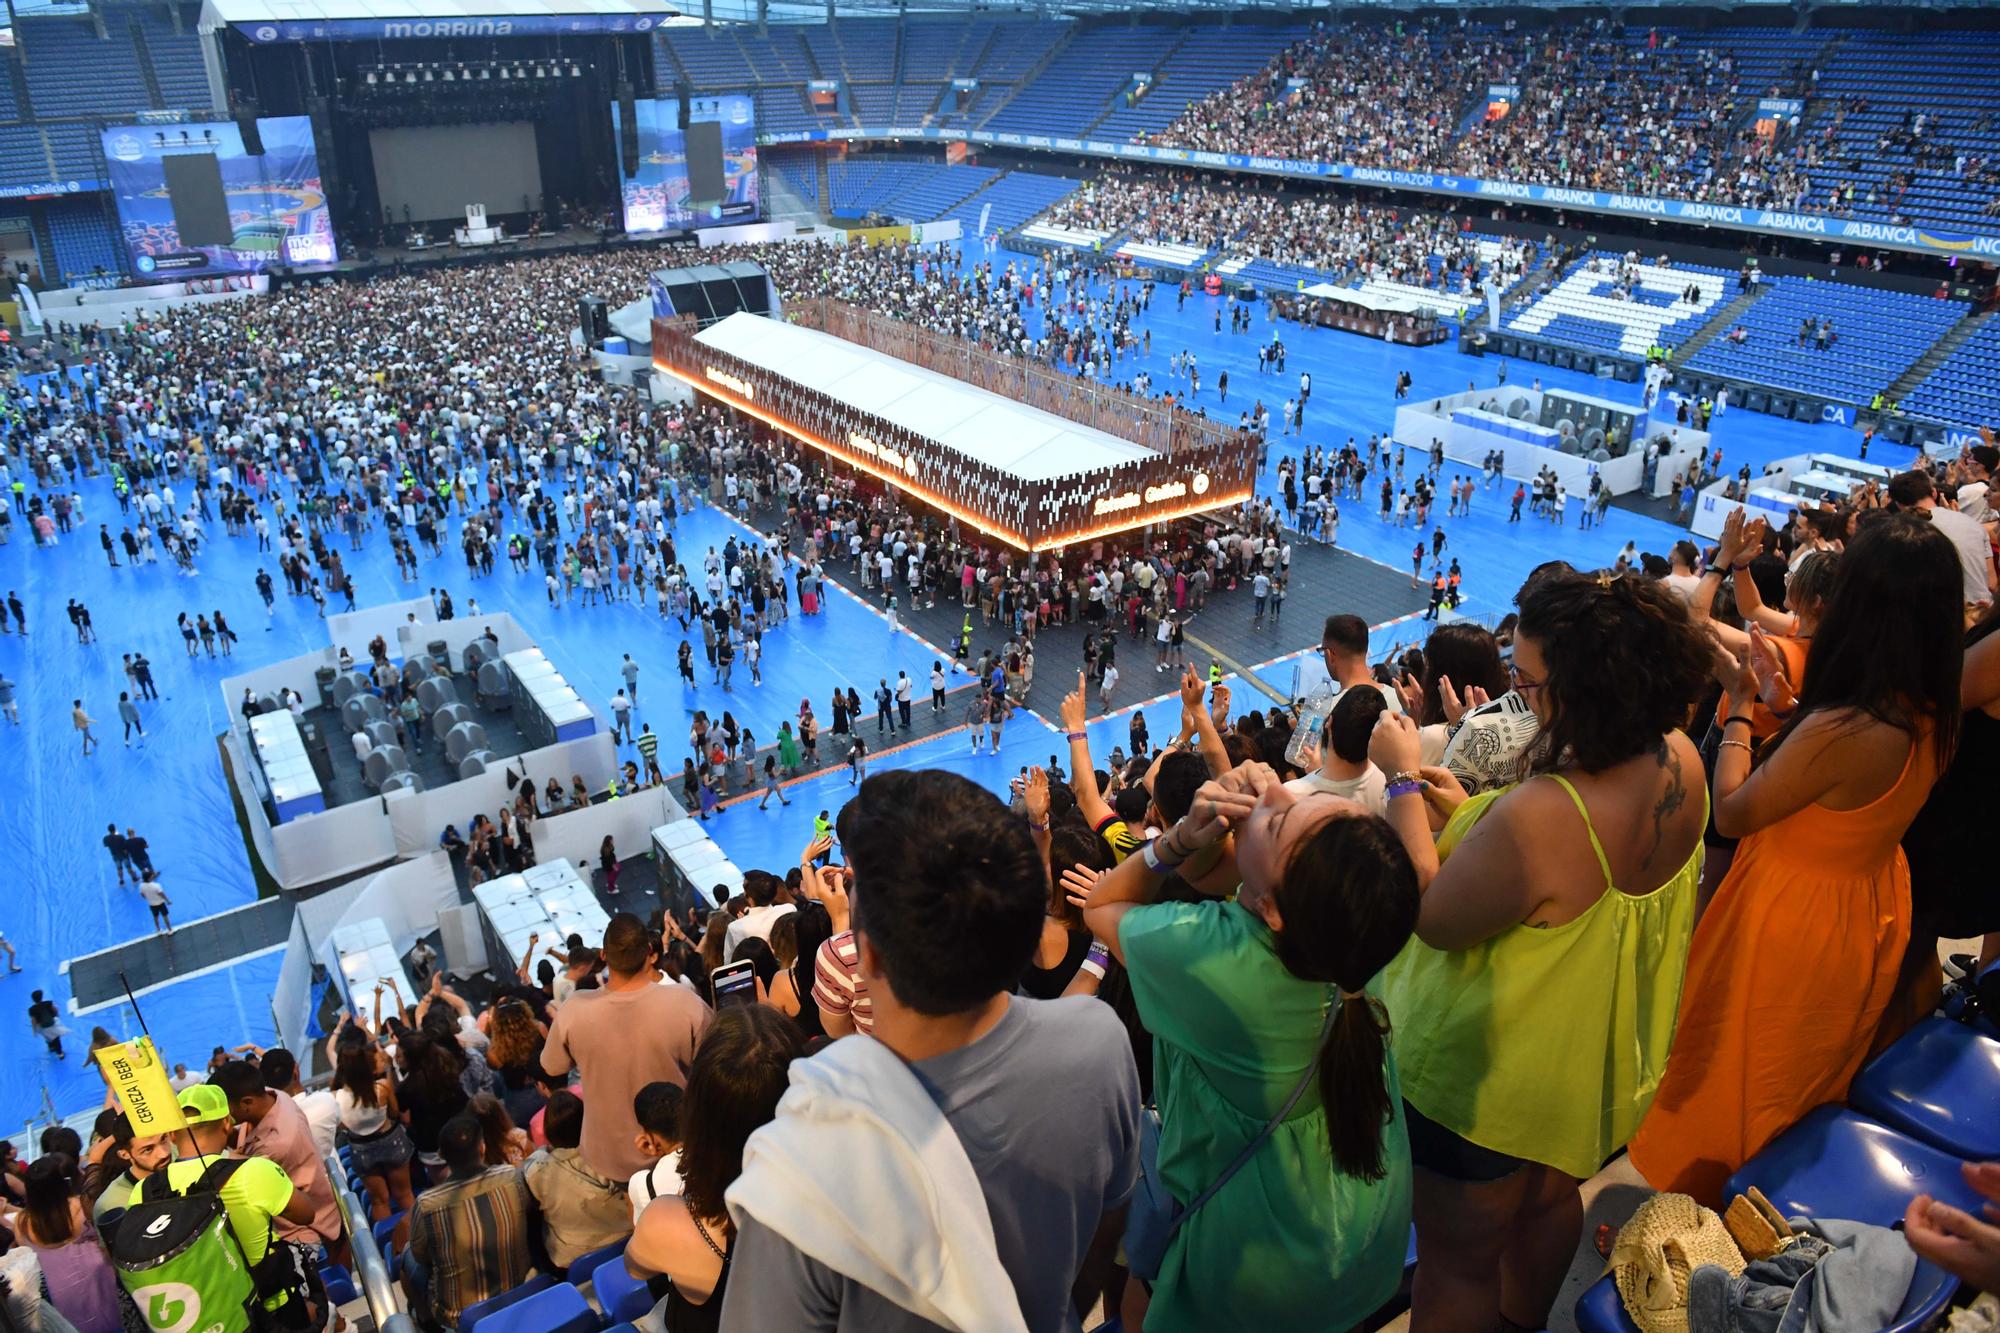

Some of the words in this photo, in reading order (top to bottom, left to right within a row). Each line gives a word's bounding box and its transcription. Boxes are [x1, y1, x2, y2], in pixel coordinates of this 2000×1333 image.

[1354, 168, 1393, 182] ABANCA
[1393, 172, 1434, 186] RIAZOR
[1486, 182, 1531, 199] ABANCA
[1546, 188, 1596, 207] ABANCA
[1612, 195, 1667, 214] ABANCA
[1685, 204, 1743, 224] ABANCA
[1764, 213, 1826, 233] ABANCA
[1849, 222, 1917, 244] ABANCA
[1093, 492, 1141, 516] Estrella
[1144, 481, 1187, 504] Galicia
[112, 1057, 134, 1081] BEER
[126, 1084, 154, 1124] CERVEZA
